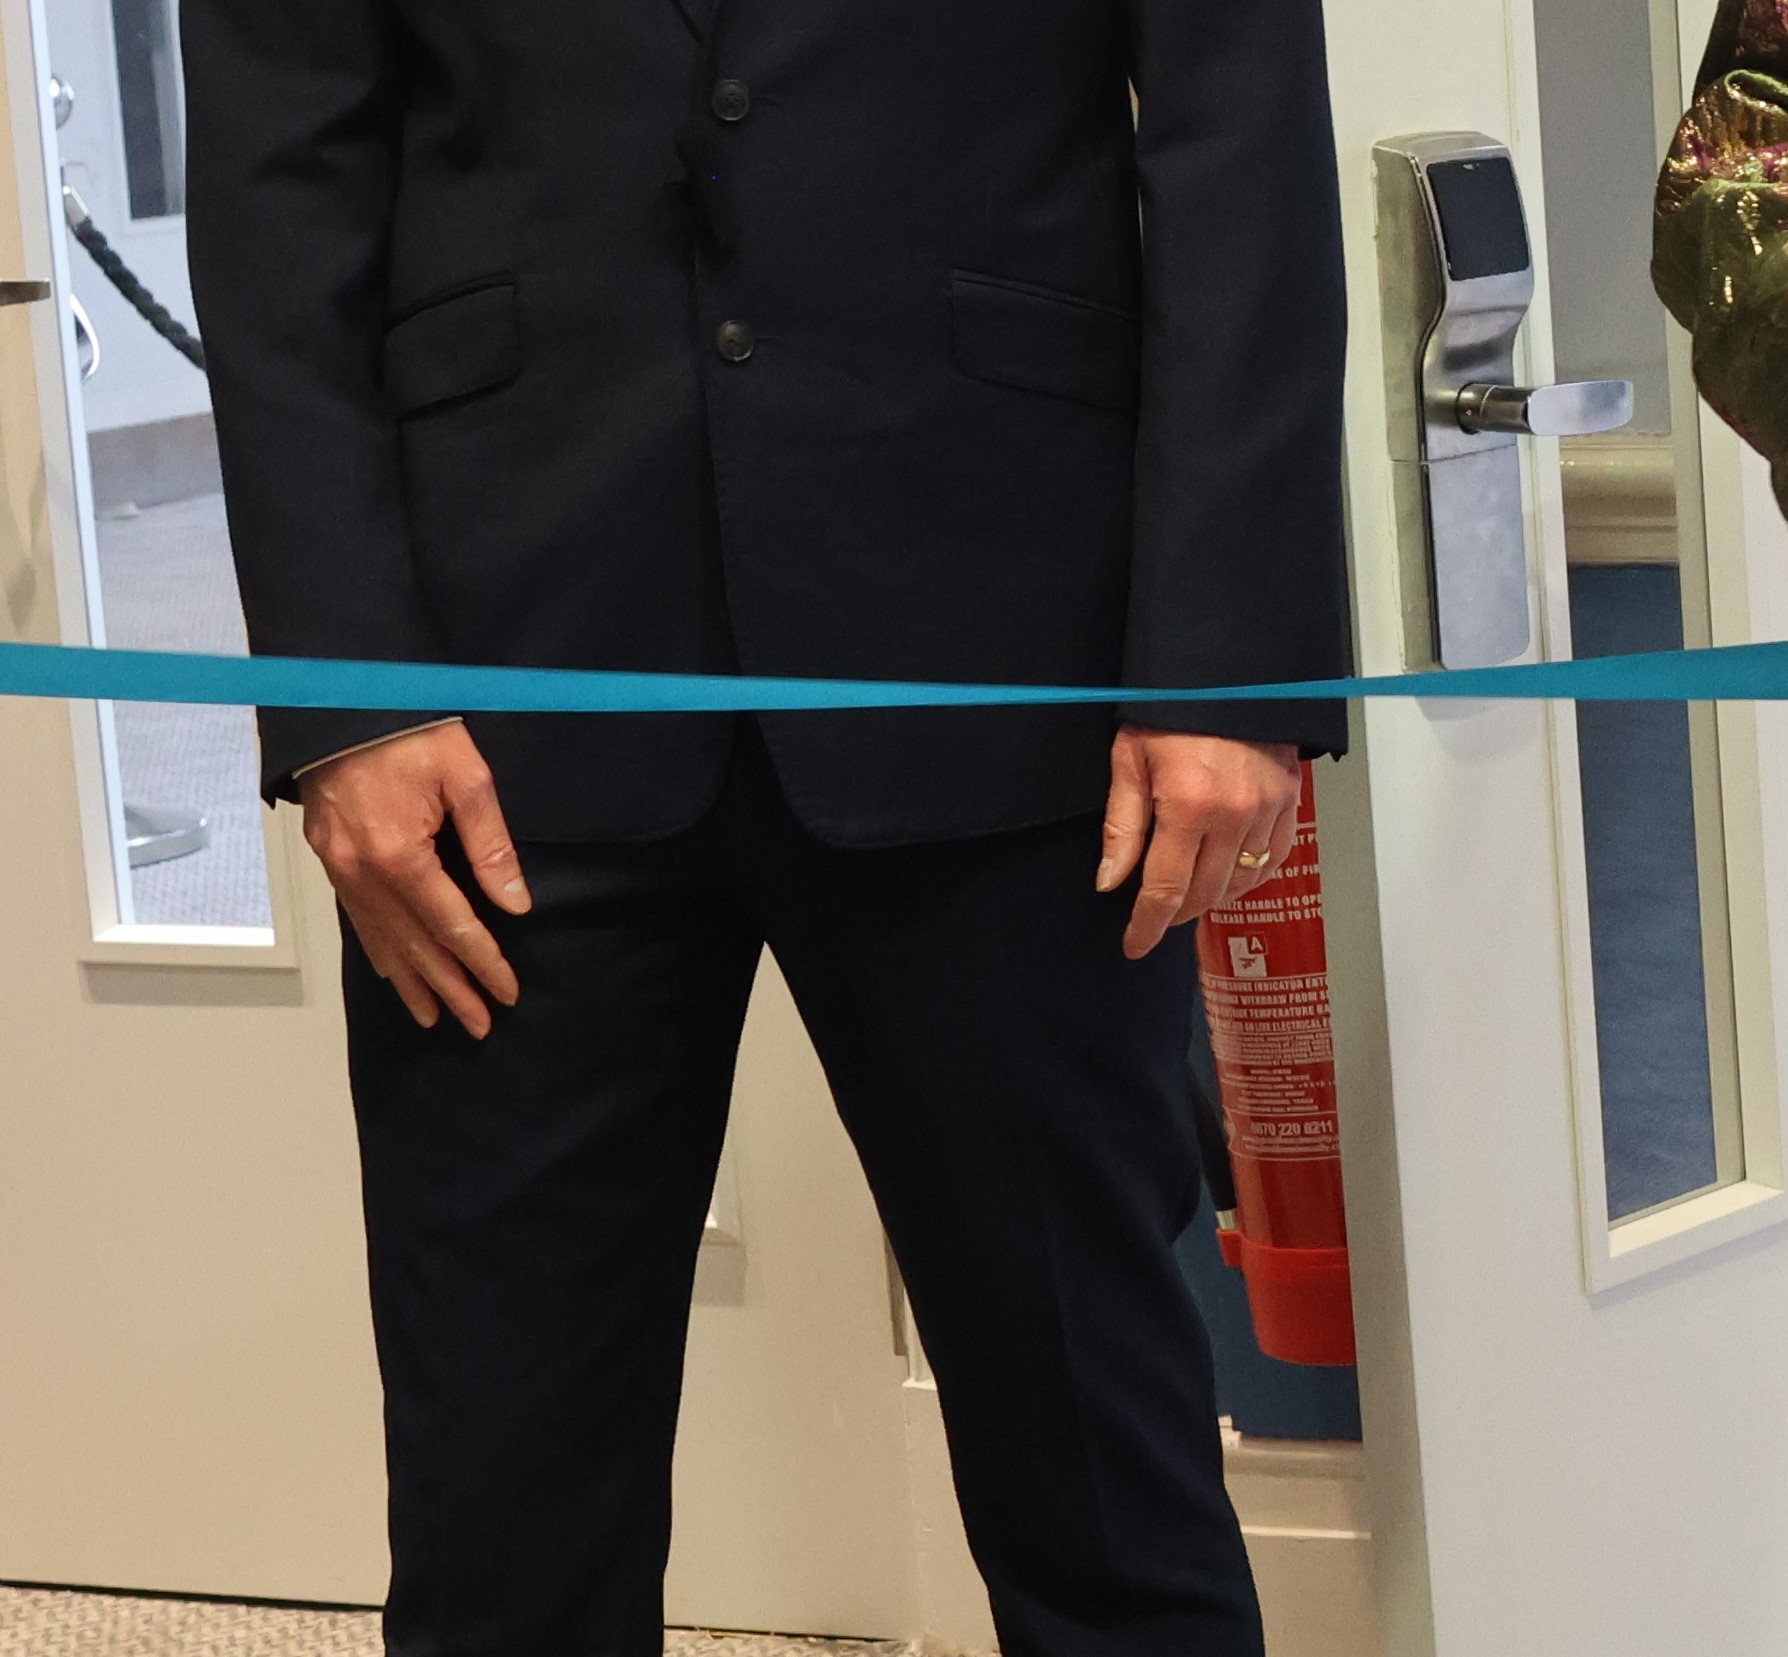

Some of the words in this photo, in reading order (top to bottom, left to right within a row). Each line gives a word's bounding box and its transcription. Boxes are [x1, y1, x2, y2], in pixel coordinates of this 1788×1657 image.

[1244, 897, 1284, 910] HANDLE
[1286, 896, 1300, 908] TO
[1246, 911, 1286, 923] HANDLE
[1288, 909, 1302, 921] TO
[1250, 935, 1264, 951] A
[1254, 978, 1304, 992] INDICATOR
[1289, 991, 1318, 1004] FROM
[1249, 1004, 1315, 1018] TEMPERATURE
[1277, 1121, 1301, 1135] 220
